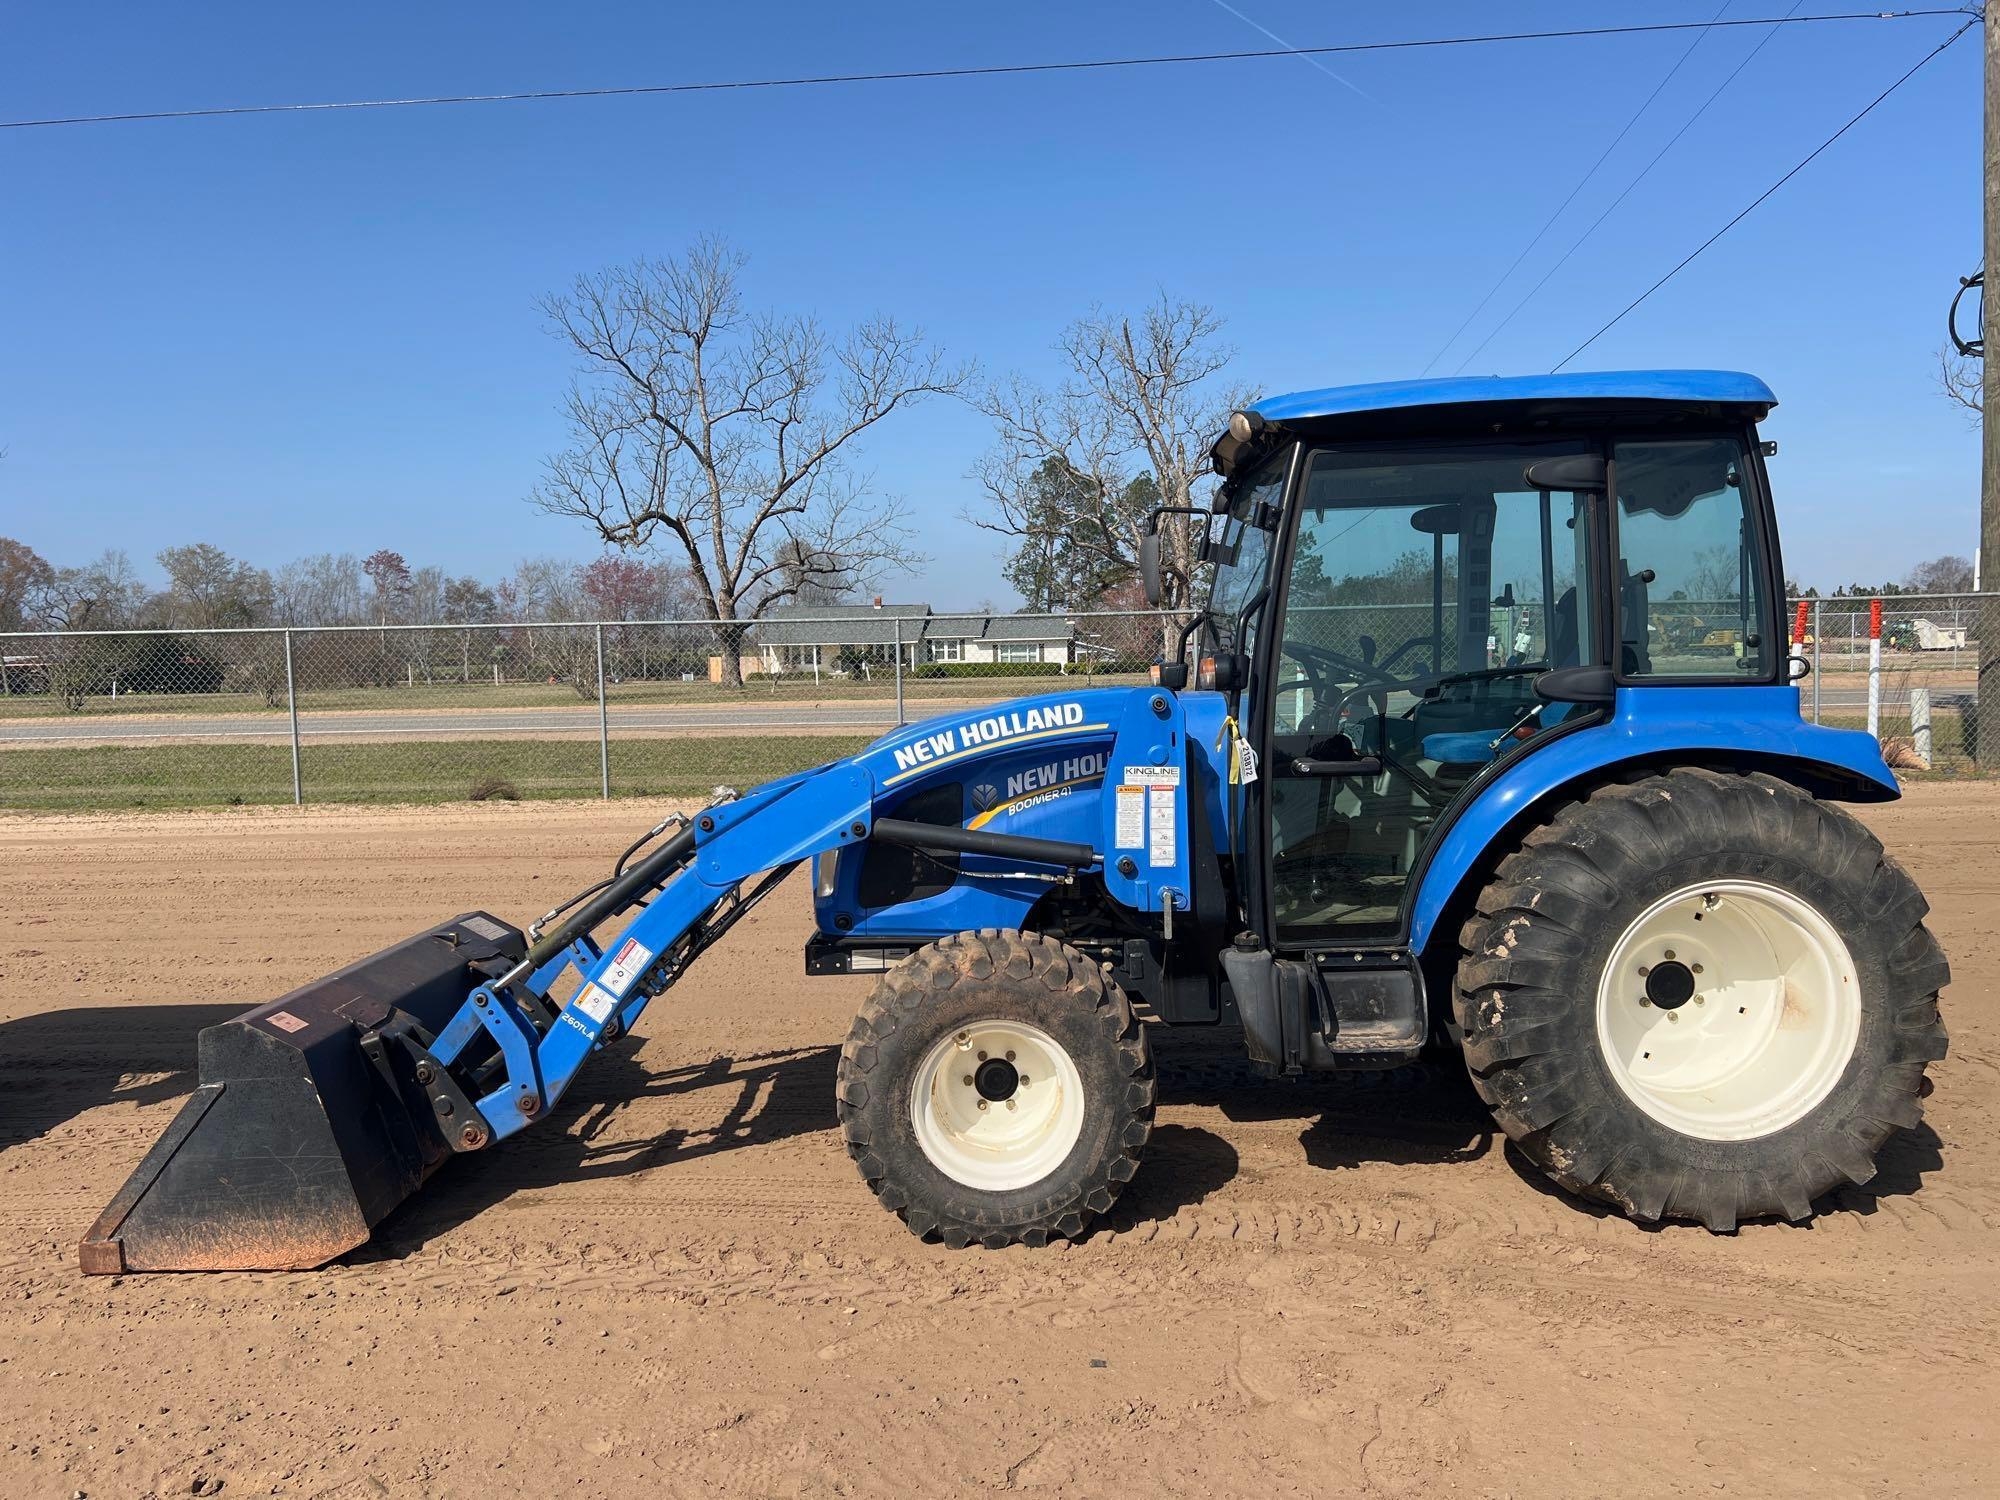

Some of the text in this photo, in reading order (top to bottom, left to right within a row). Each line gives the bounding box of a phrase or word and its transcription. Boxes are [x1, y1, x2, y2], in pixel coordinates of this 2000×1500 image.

[893, 703, 1084, 770] NEW HOLLAND
[1007, 751, 1111, 798] NEW HOL
[1125, 767, 1179, 775] KINGLINE
[1242, 746, 1254, 776] 213872
[1008, 786, 1072, 817] BOOMER 41
